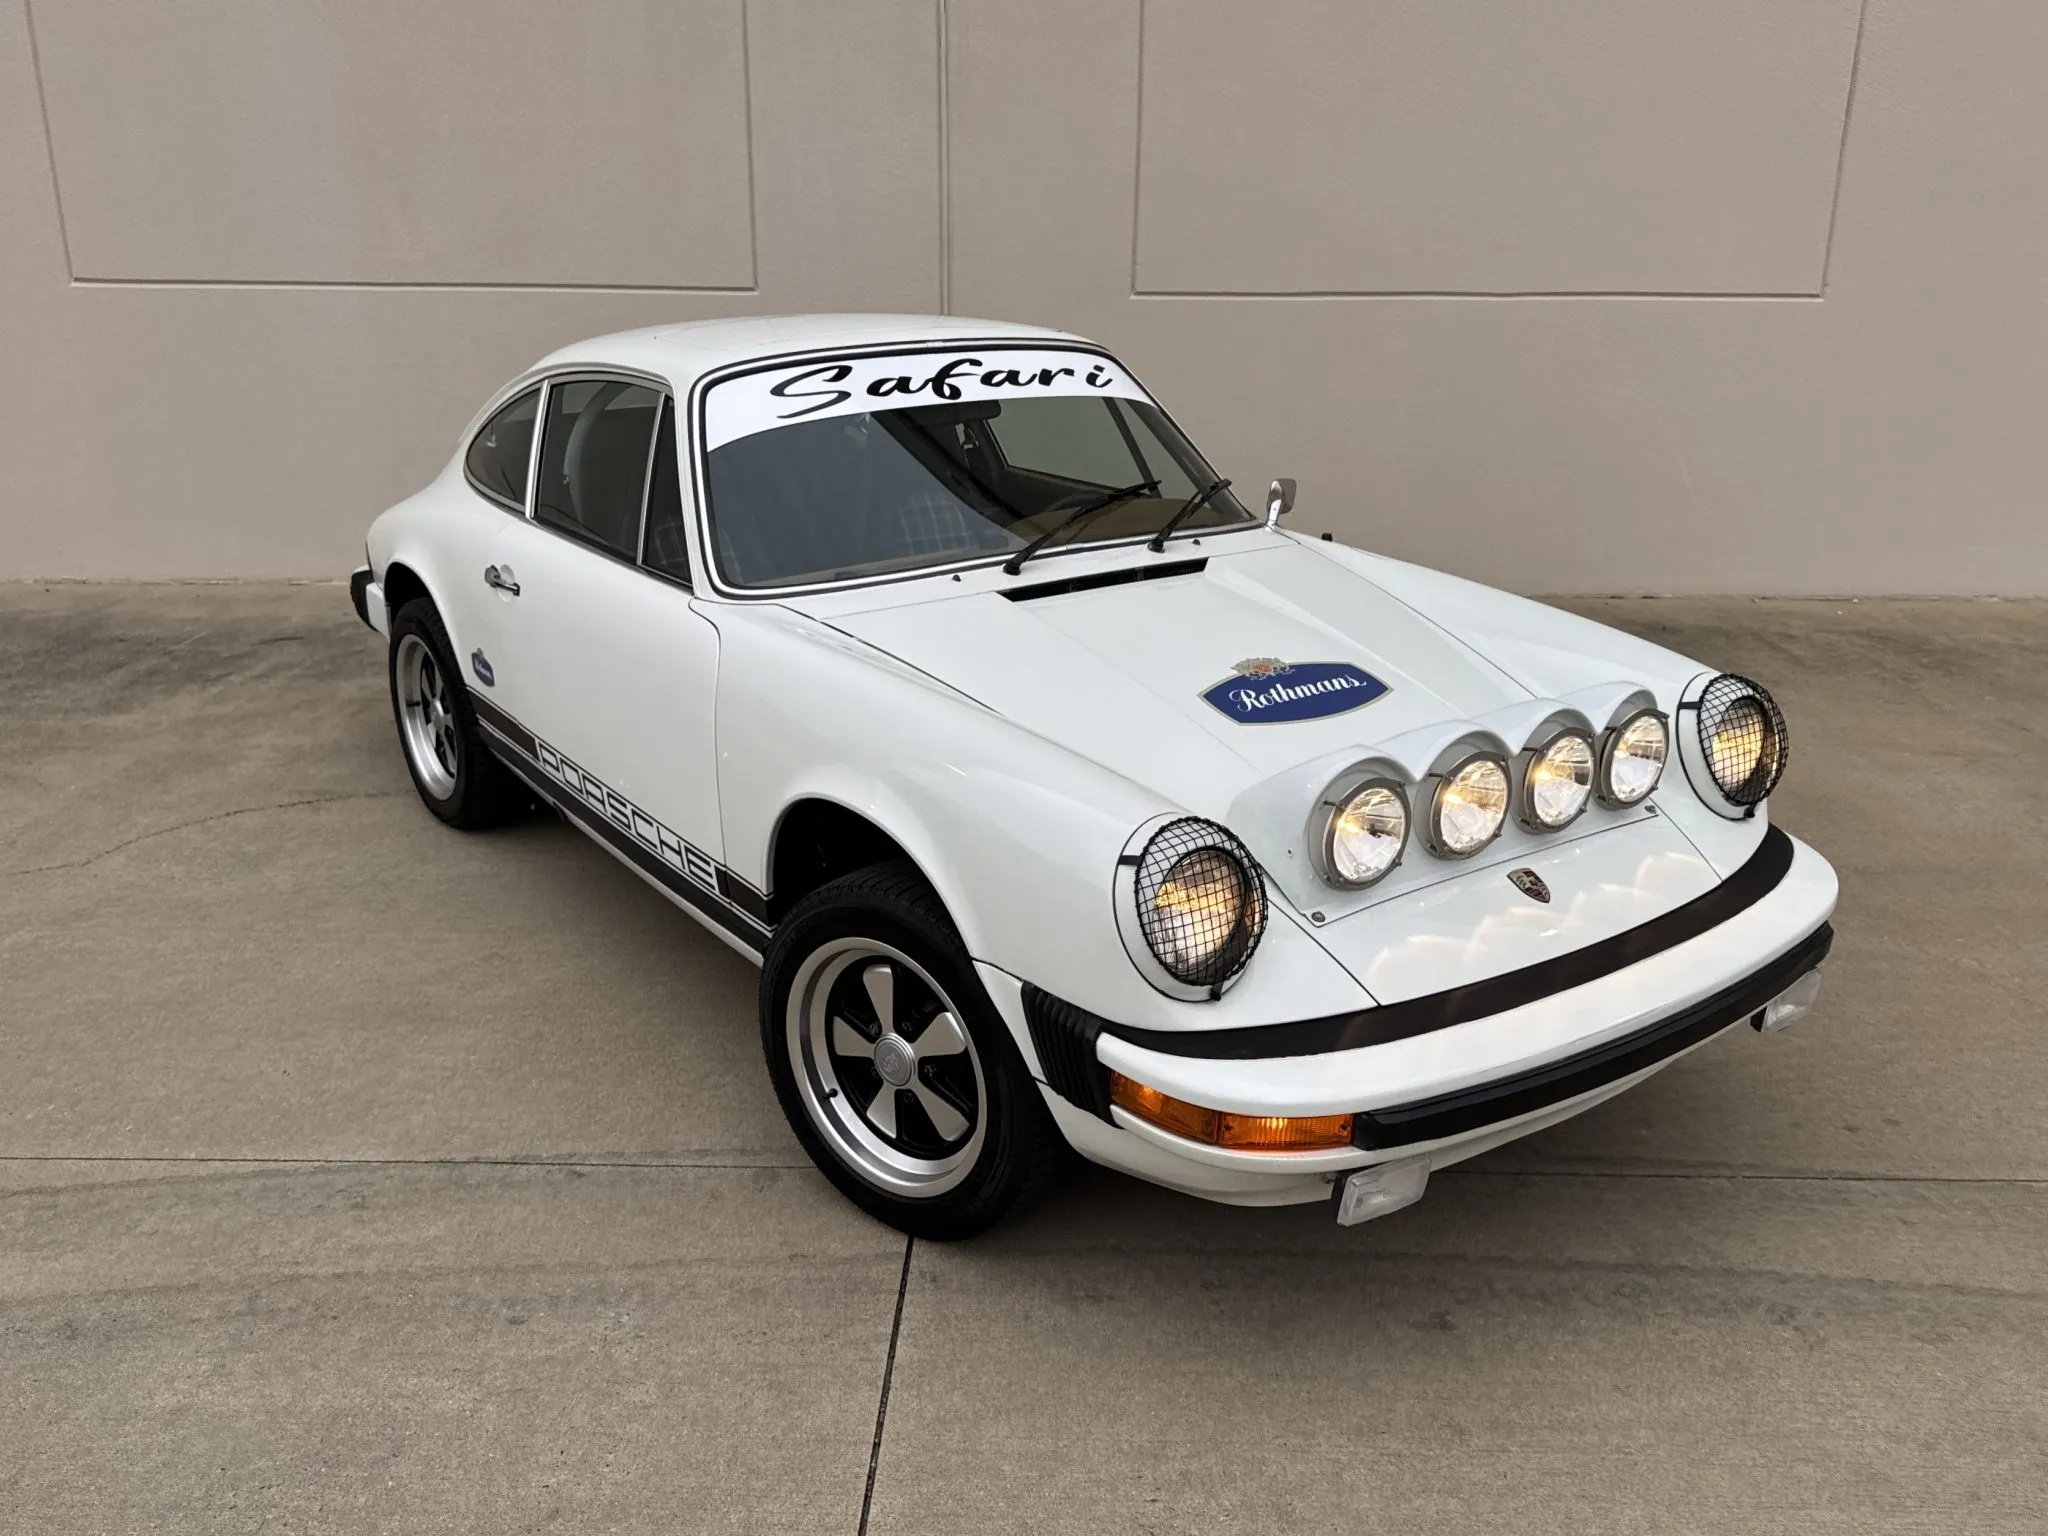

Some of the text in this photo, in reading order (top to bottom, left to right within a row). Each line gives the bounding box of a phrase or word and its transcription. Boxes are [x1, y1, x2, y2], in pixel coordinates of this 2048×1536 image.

[770, 359, 1114, 418] Safari
[1229, 675, 1366, 712] Rothmans
[538, 741, 716, 891] PORSCHE
